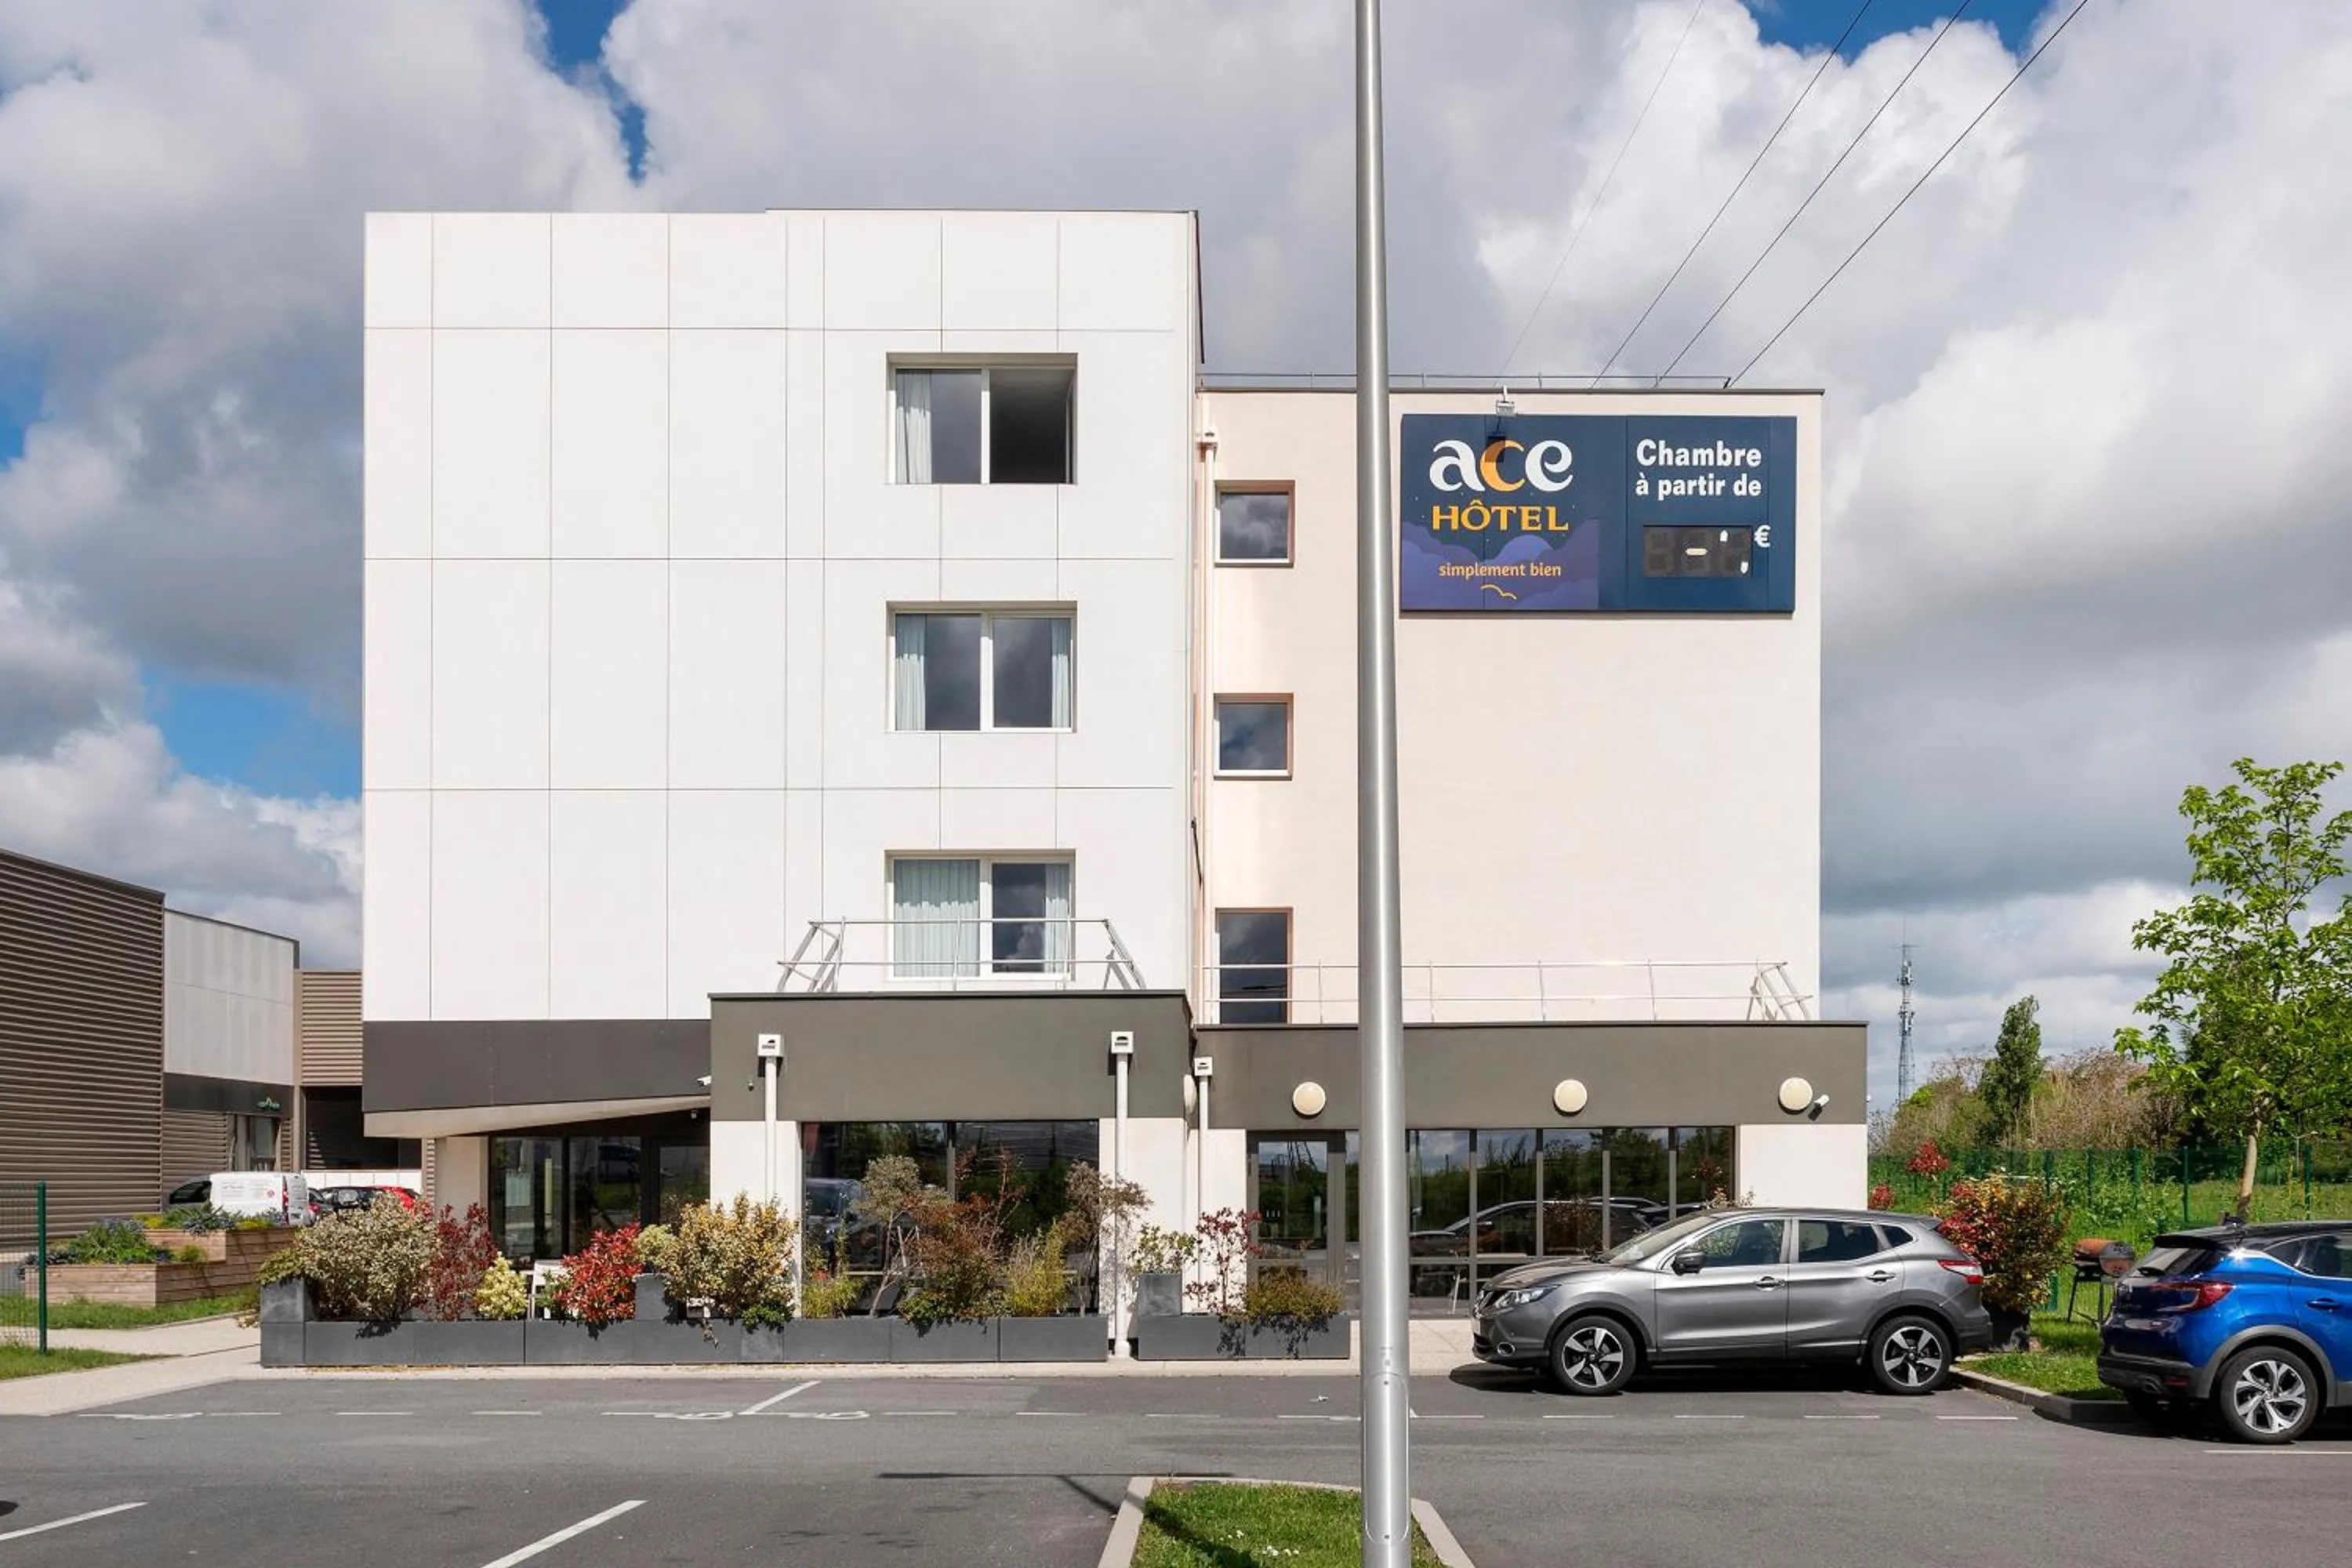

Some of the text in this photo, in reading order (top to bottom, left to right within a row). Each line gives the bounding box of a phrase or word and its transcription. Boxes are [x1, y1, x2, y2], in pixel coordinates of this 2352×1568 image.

[1429, 439, 1573, 492] ace
[1636, 438, 1762, 467] Chambre
[1635, 471, 1762, 501] à partir de
[1432, 499, 1569, 532] HÔTEL
[1754, 524, 1772, 548] €
[1439, 562, 1562, 580] simplement bien
